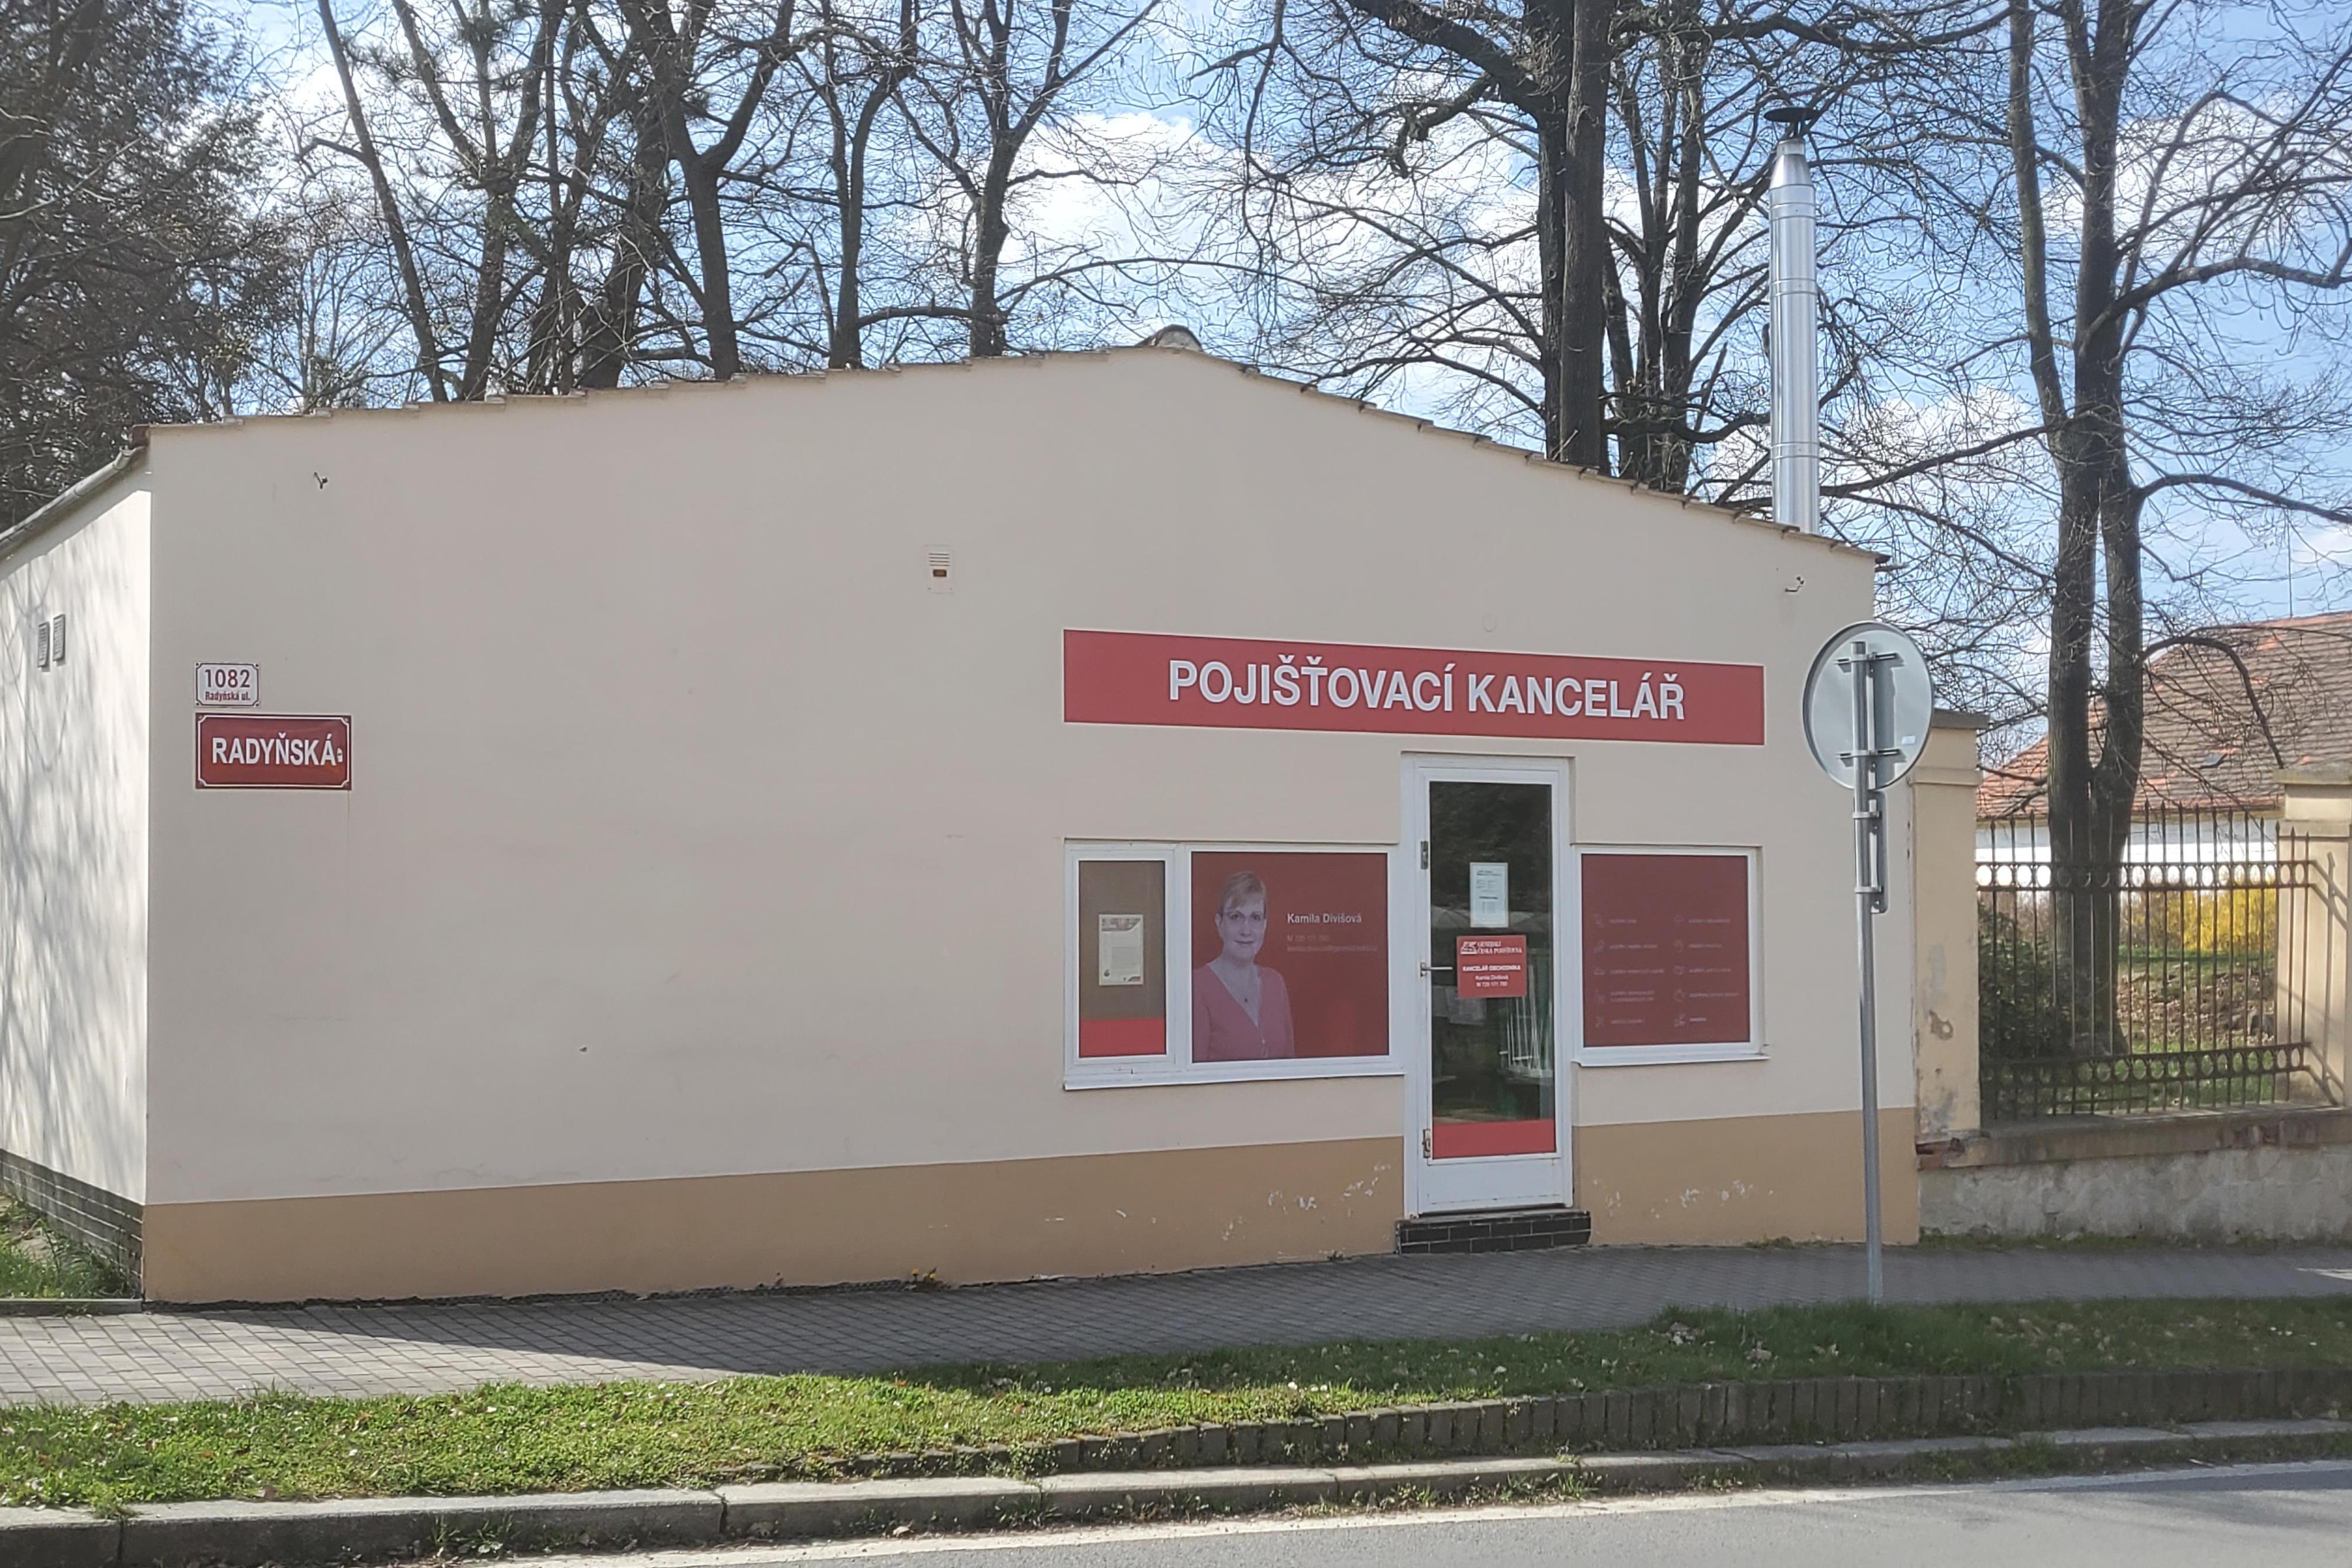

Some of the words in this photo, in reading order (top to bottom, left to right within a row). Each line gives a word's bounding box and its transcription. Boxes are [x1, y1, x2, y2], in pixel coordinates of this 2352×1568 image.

[205, 668, 250, 688] 1082
[1169, 654, 1455, 712] POJIŠŤOVACÍ
[1468, 672, 1685, 720] KANCELÁŘ
[205, 690, 239, 702] Radyňská
[242, 691, 250, 701] ul.
[212, 731, 336, 766] RADYŇSKÁ
[1287, 913, 1320, 923] Kamila
[1323, 912, 1362, 923] Divišová
